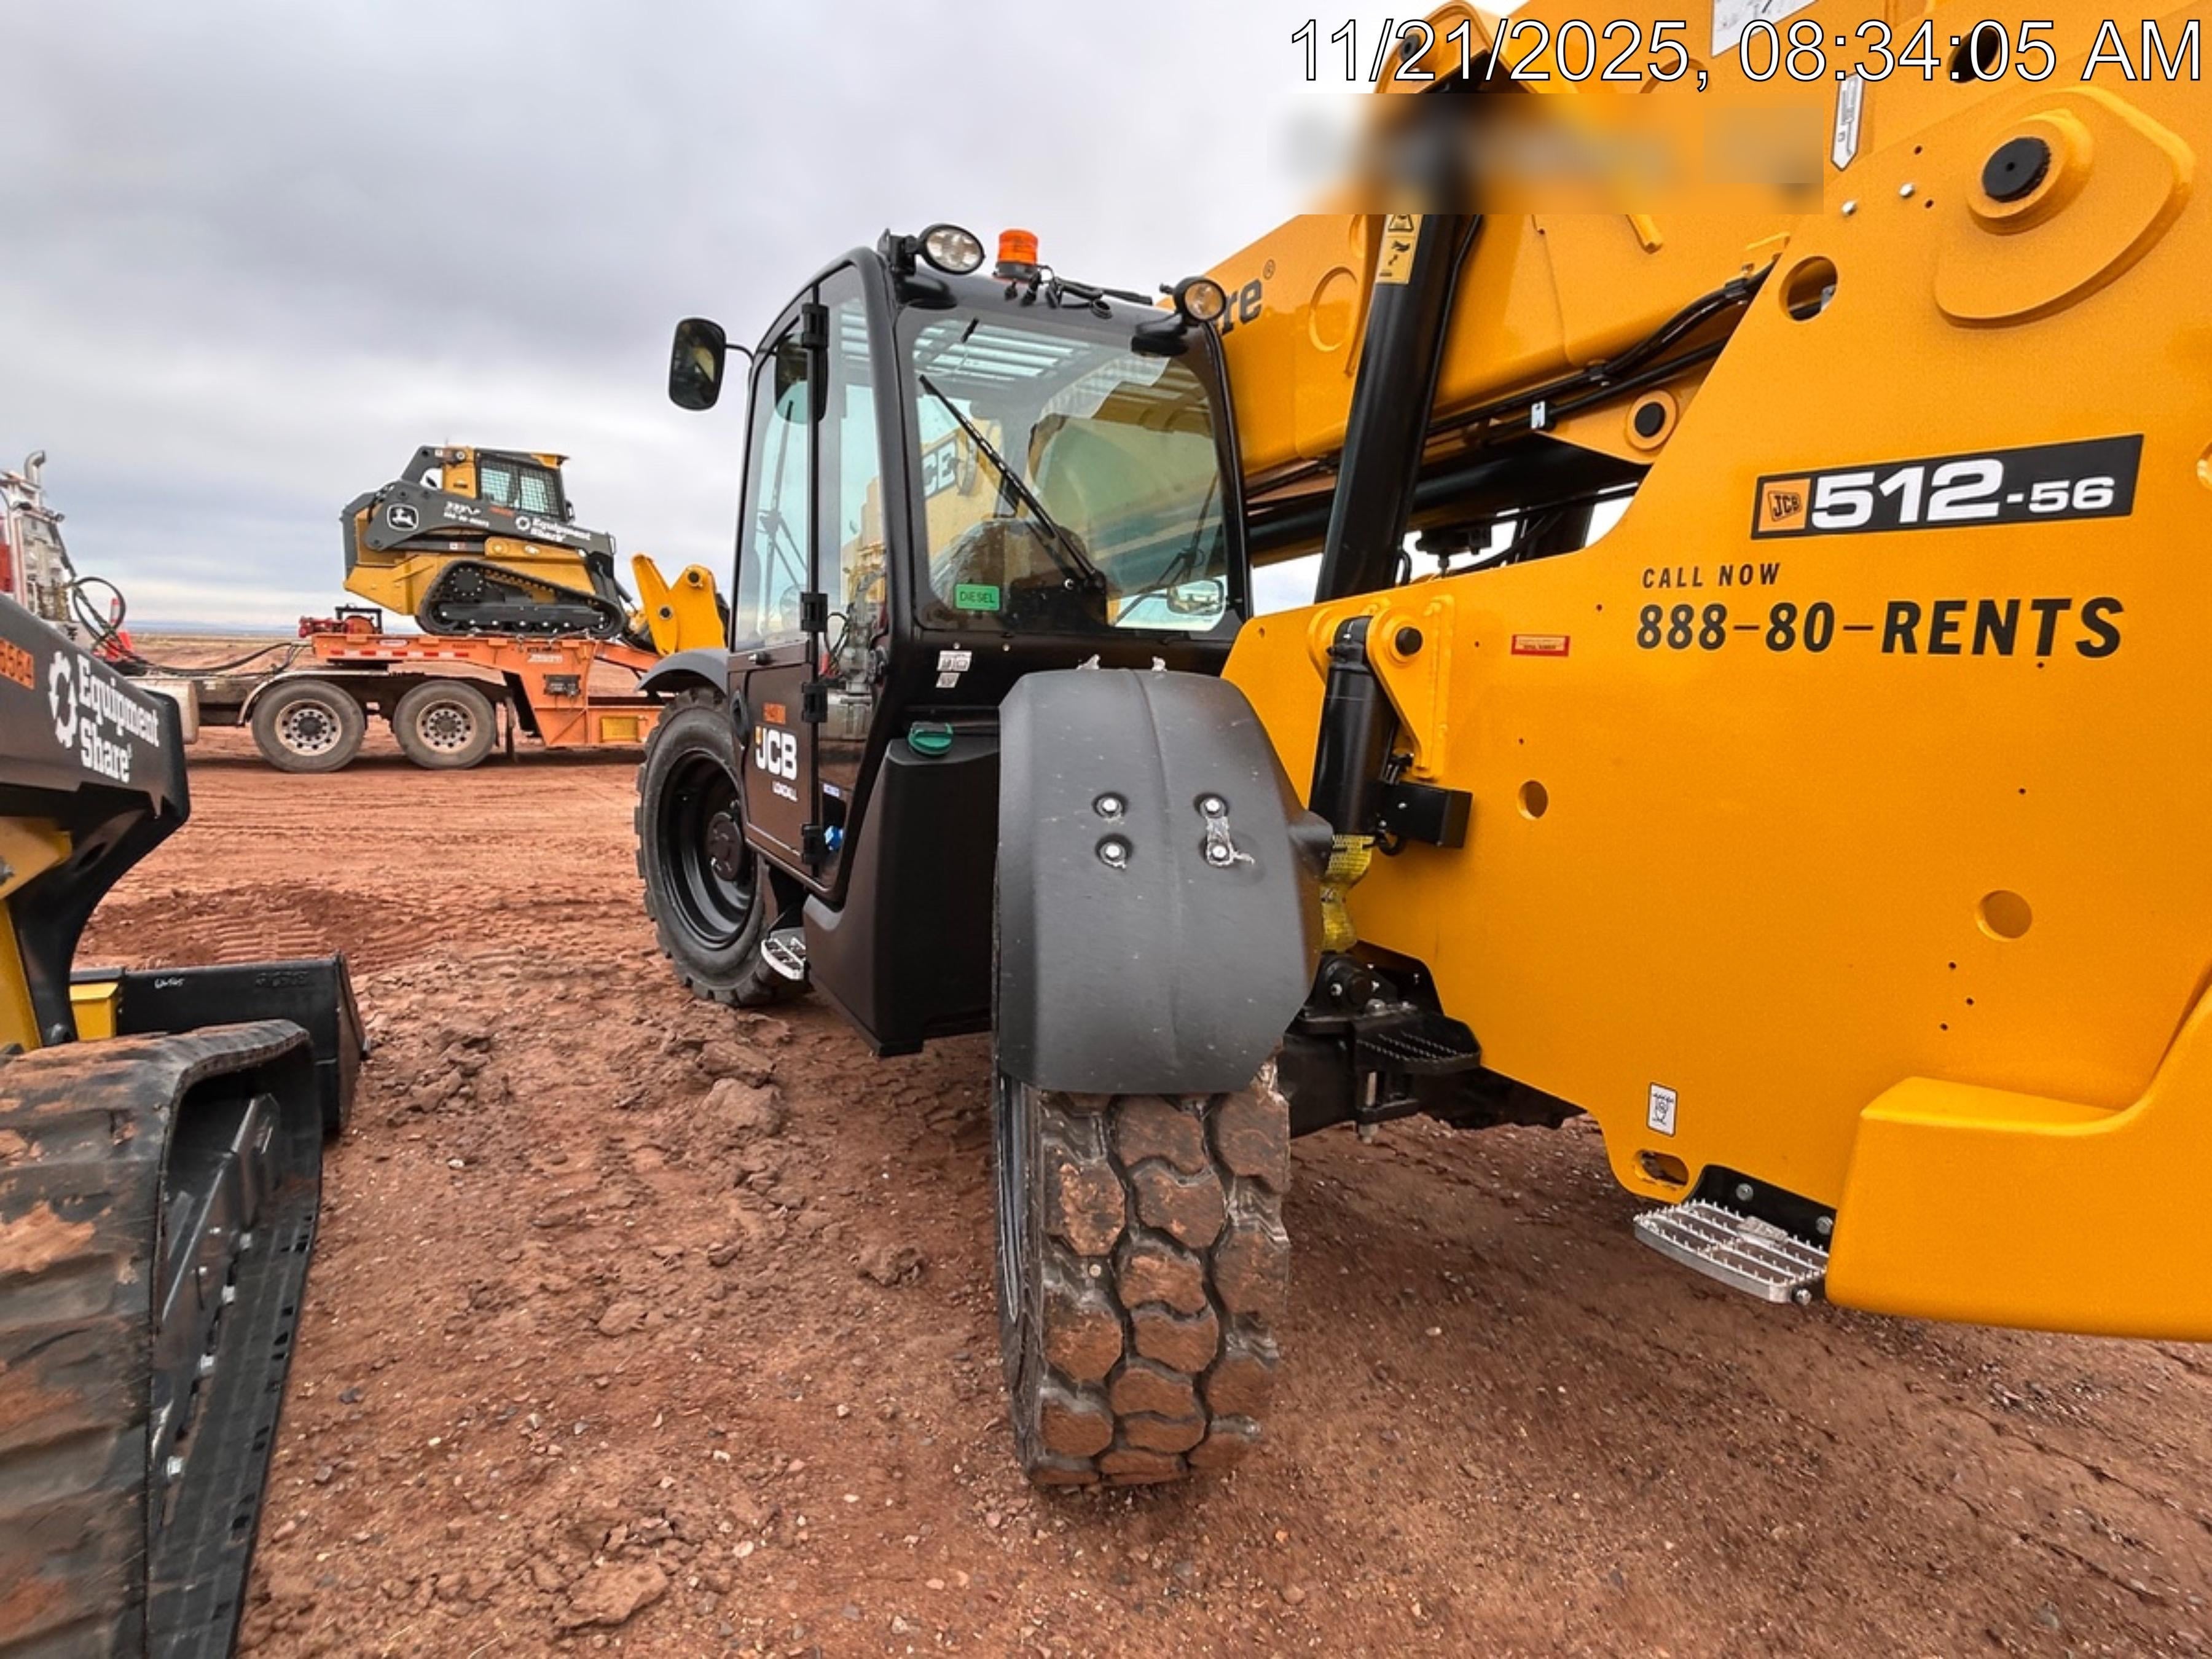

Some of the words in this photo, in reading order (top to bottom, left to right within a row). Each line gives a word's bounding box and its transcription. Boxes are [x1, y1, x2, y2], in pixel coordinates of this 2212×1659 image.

[1773, 495, 1800, 517] JCB
[1811, 458, 2115, 528] 512-56
[960, 591, 995, 603] DIESEL
[1642, 566, 1704, 588] CALL
[1719, 563, 1781, 586] NOW
[1636, 597, 2124, 657] 888-80-RENTS
[77, 654, 159, 747] Equipment
[80, 716, 130, 782] Share
[755, 726, 798, 780] JCB
